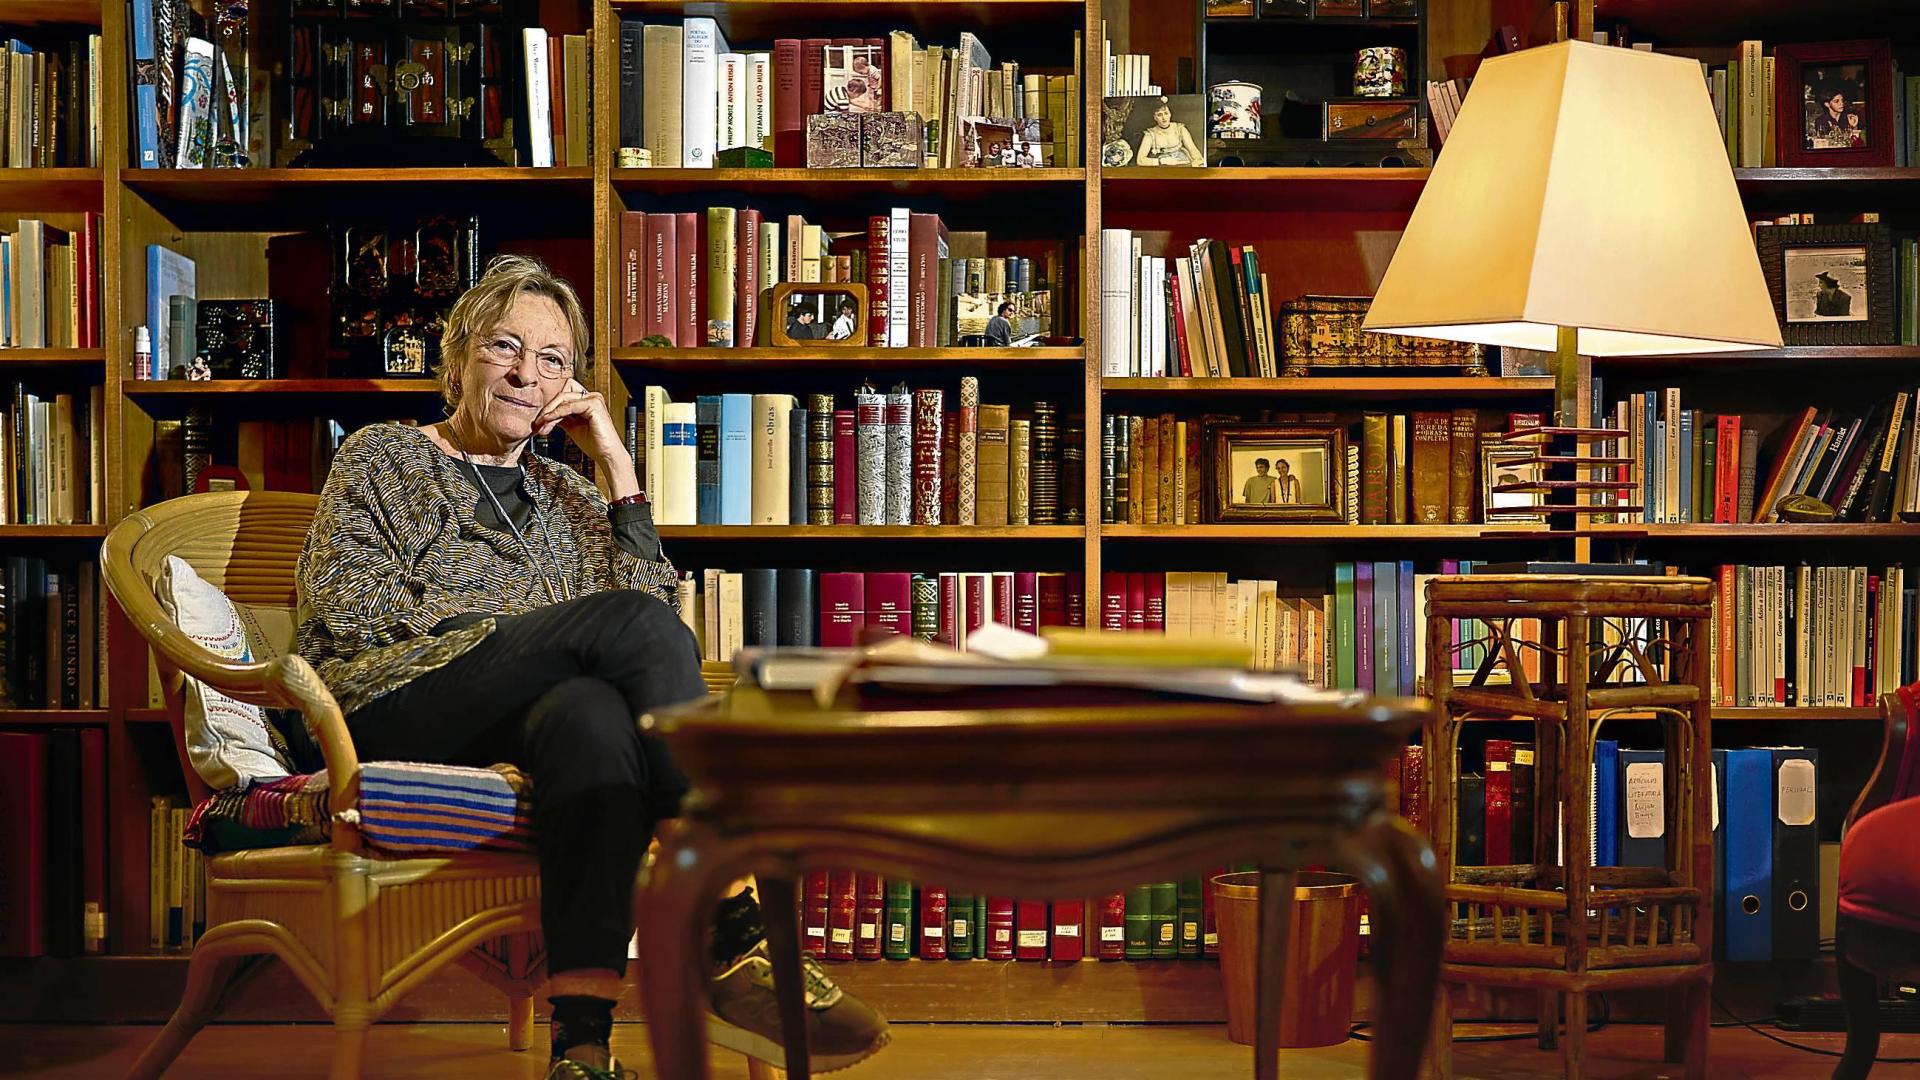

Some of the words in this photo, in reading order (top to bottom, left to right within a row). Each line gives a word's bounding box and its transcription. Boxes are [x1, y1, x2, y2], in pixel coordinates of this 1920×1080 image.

[160, 70, 172, 106] El
[1636, 406, 1644, 436] Rotterdam
[767, 439, 776, 458] Zorrilla
[1829, 427, 1847, 453] Hamlet
[1366, 423, 1384, 518] BAROJA
[66, 584, 77, 626] ALICE
[973, 580, 982, 598] Gaula
[66, 632, 77, 687] MUNRO
